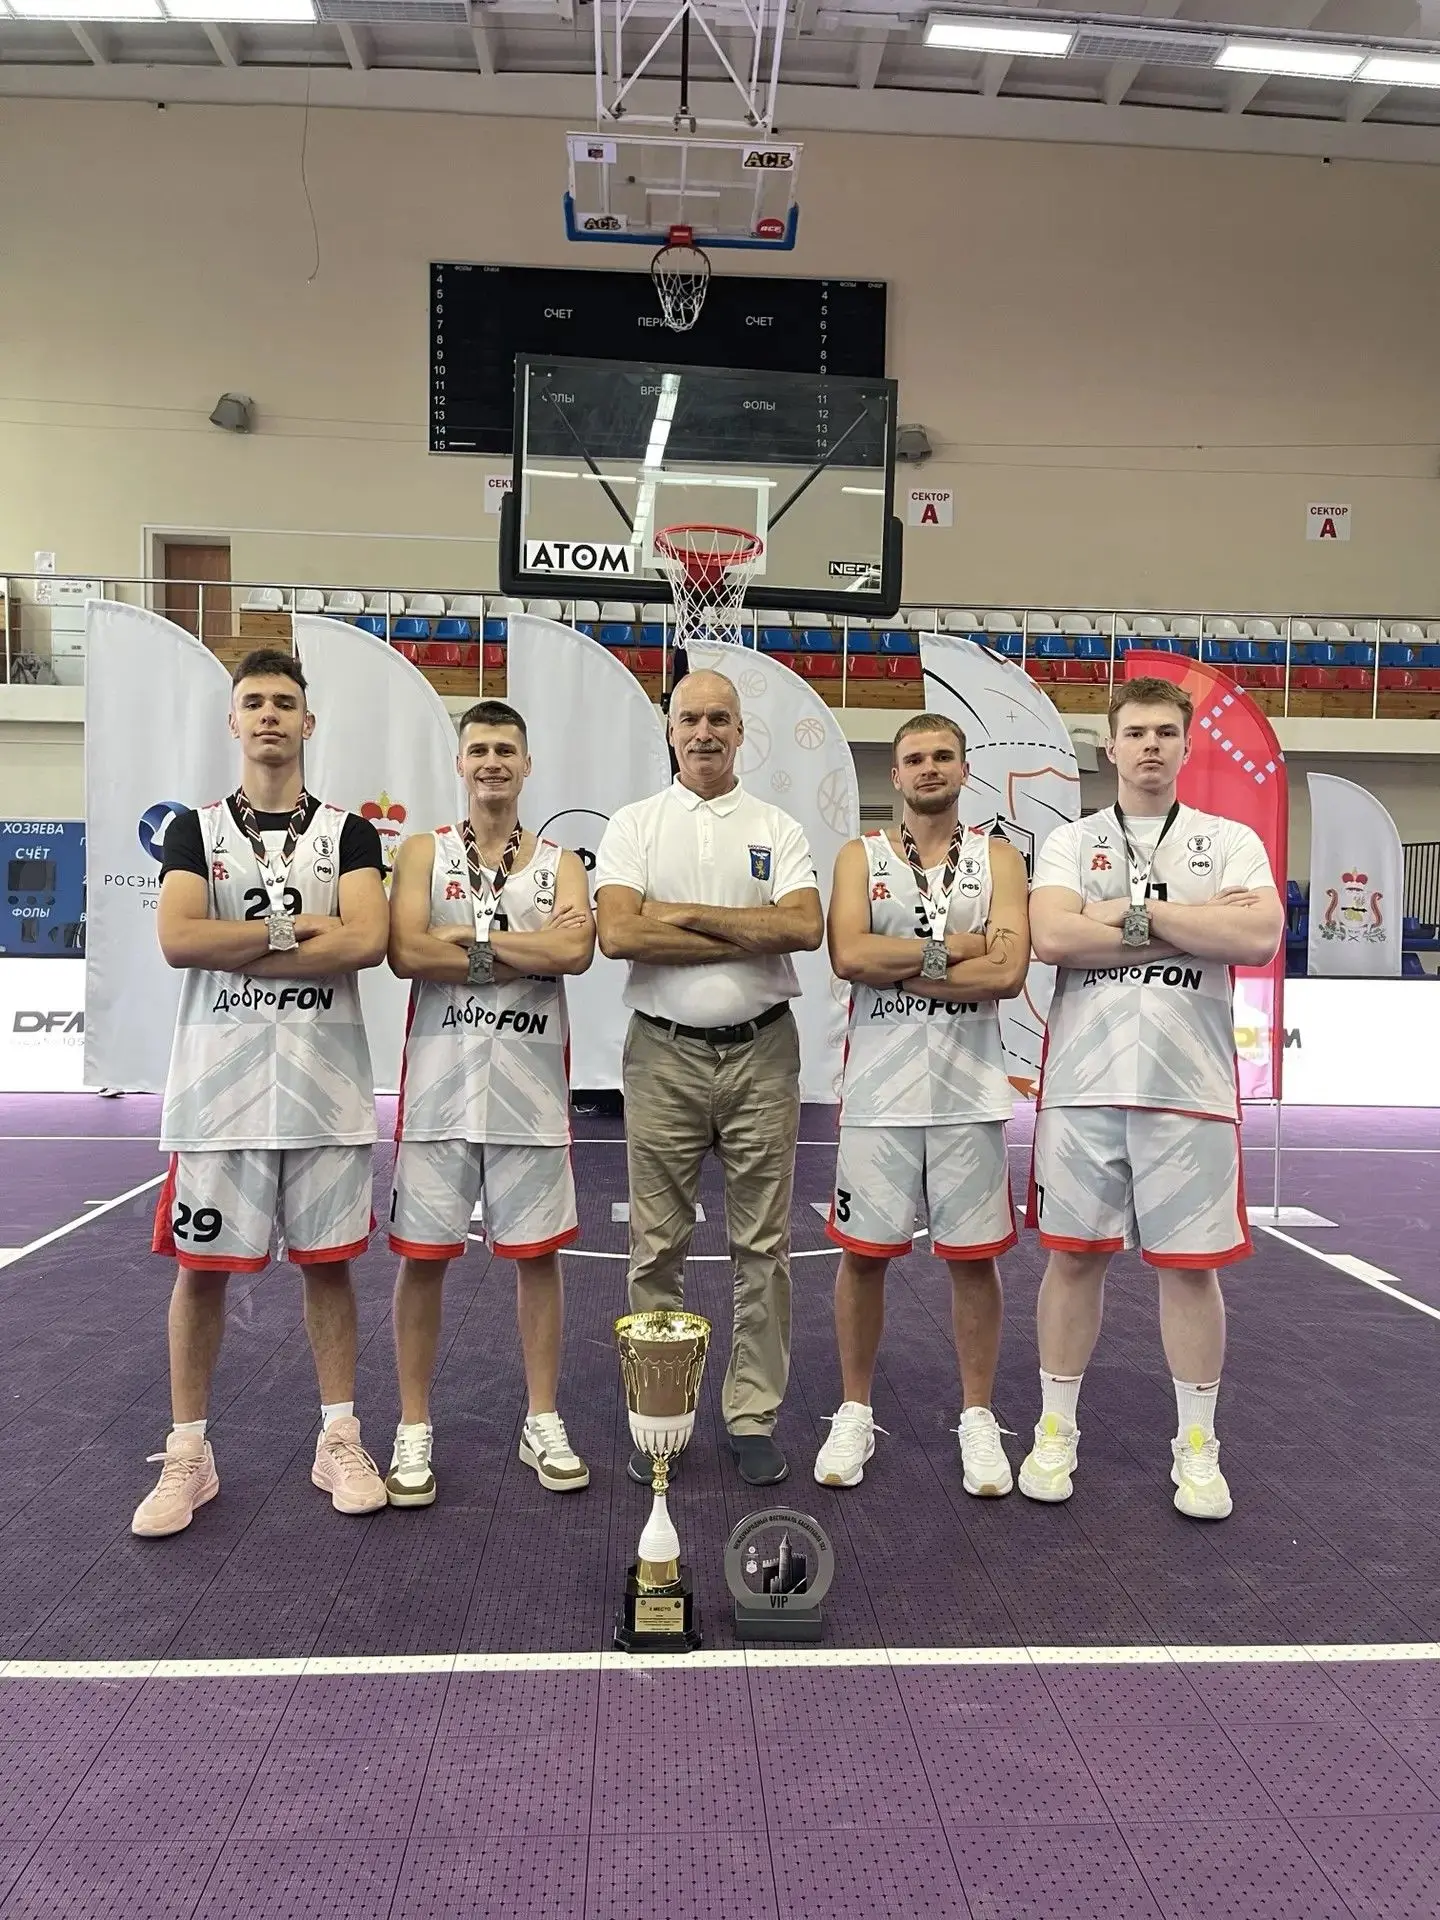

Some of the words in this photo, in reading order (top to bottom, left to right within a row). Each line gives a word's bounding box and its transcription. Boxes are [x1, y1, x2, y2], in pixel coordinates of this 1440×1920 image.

[436, 274, 443, 284] 4
[436, 289, 443, 299] 5
[821, 291, 828, 300] 4
[436, 304, 443, 314] 6
[544, 308, 573, 319] СЧЕТ
[821, 306, 828, 315] 5
[437, 319, 444, 329] 7
[745, 316, 774, 326] СЧЕТ
[820, 320, 827, 330] 6
[436, 335, 443, 344] 8
[821, 335, 827, 344] 7
[436, 350, 443, 360] 9
[820, 350, 827, 360] 8
[434, 365, 446, 375] 10
[820, 365, 827, 374] 9
[435, 381, 445, 390] 11
[434, 395, 446, 405] 12
[541, 393, 575, 403] ОЛЫ
[817, 395, 827, 404] 11
[742, 400, 776, 411] ФОЛЫ
[434, 411, 445, 420] 13
[818, 409, 829, 419] 12
[435, 426, 446, 435] 14
[816, 424, 828, 433] 13
[434, 440, 446, 450] 15
[816, 438, 827, 448] 14
[488, 479, 514, 489] СЕКТ
[911, 491, 950, 501] СЕКТОР
[921, 503, 939, 524] А
[1310, 506, 1349, 516] СЕКТОР
[1320, 518, 1337, 538] А
[3, 823, 64, 835] ХОЗЯЕВА
[15, 845, 50, 859] СЧЁТ
[104, 874, 161, 888] РОСЭН
[962, 883, 980, 891] РФБ
[244, 887, 302, 921] 29
[12, 907, 50, 918] ФОЛЫ
[837, 1188, 851, 1223] 3
[173, 1202, 223, 1243] 29
[770, 1595, 789, 1608] VIP
